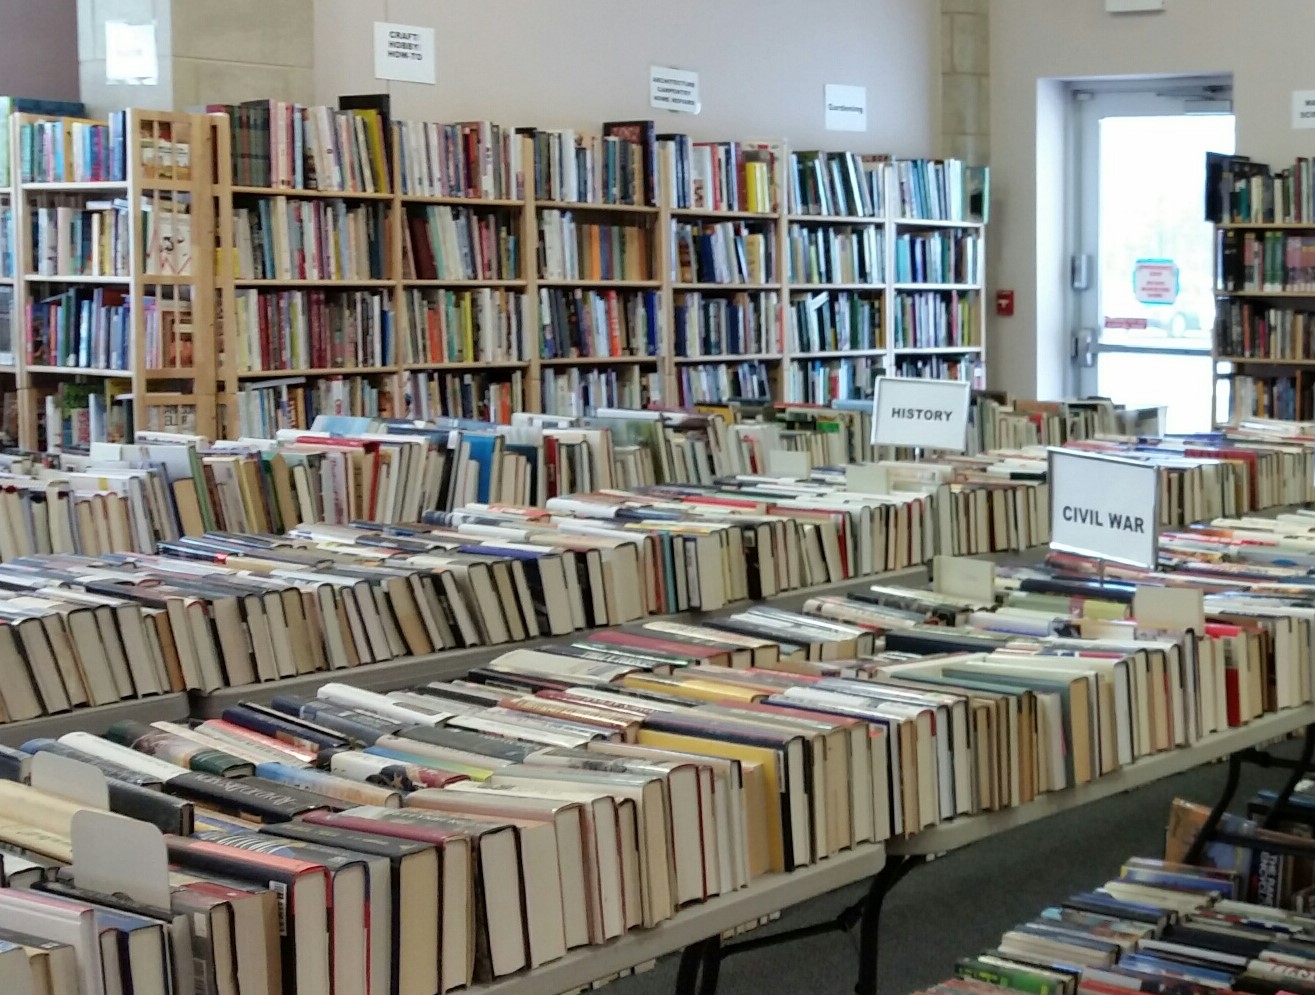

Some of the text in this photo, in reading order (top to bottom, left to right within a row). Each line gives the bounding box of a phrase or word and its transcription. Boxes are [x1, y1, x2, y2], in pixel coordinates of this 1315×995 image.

[828, 103, 863, 115] Gardening
[891, 407, 953, 422] HISTORY
[1062, 505, 1145, 534] CIVIL WAR
